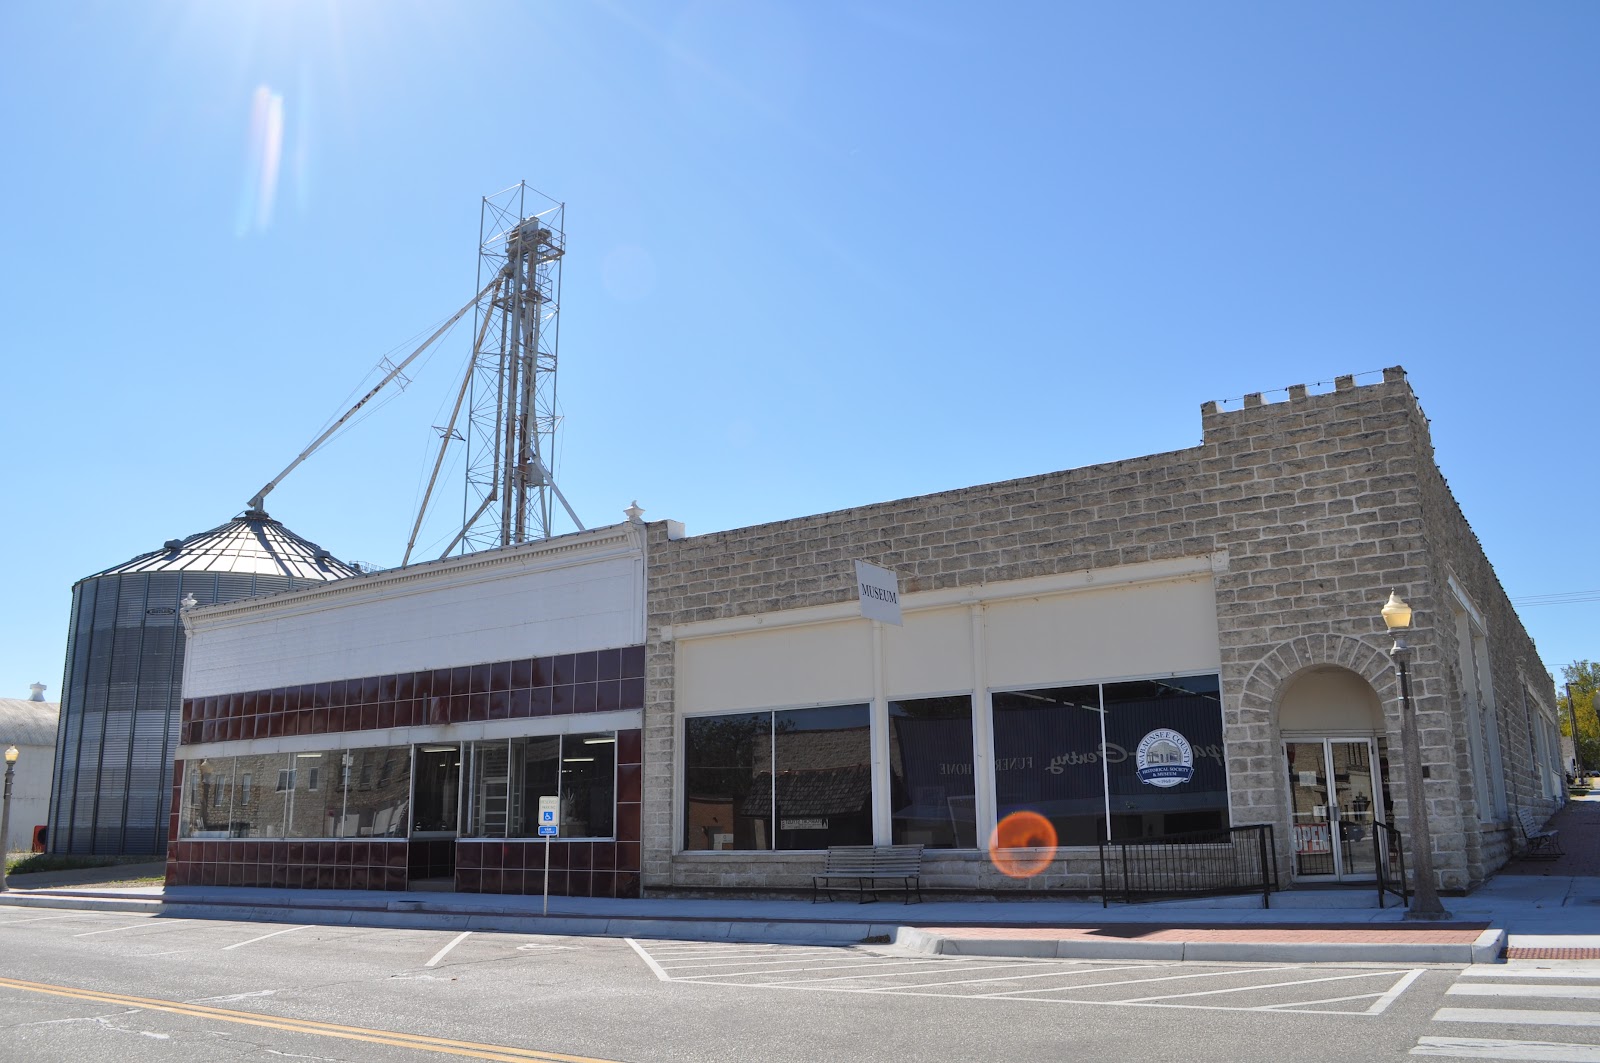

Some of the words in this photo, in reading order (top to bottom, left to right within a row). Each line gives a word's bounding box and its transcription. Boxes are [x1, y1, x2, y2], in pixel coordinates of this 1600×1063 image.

[861, 583, 897, 604] MUSEUM
[1139, 731, 1171, 767] WABAUNSEE
[1172, 734, 1190, 766] COUNTY
[1293, 826, 1329, 851] OPEN
